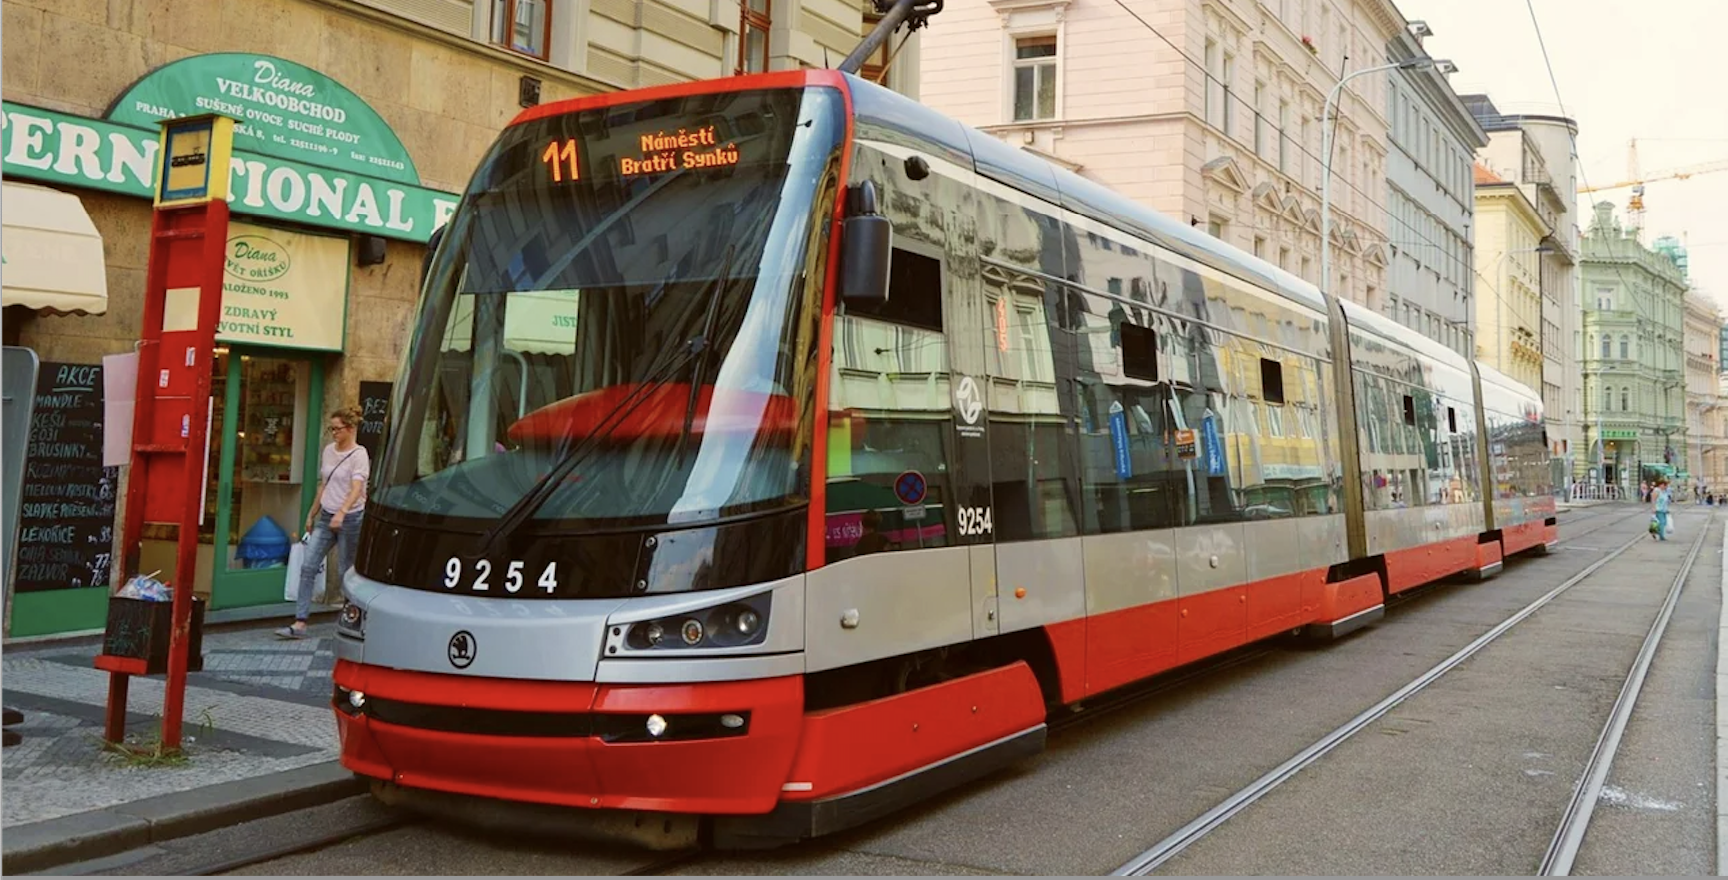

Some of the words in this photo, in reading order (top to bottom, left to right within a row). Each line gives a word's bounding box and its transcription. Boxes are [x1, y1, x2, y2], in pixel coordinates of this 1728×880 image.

[254, 60, 316, 98] Diana
[135, 101, 176, 118] PRAHA
[216, 77, 346, 123] VELKOOBCHOD
[195, 96, 244, 117] SUŠENÉ
[246, 108, 283, 126] OVOCE
[288, 119, 324, 137] SUCHÉ
[326, 128, 361, 145] PLODY
[641, 126, 715, 152] Náměstí
[542, 138, 579, 182] 11
[621, 152, 676, 175] Bratří
[682, 142, 739, 169] Synků
[234, 241, 277, 262] Diana
[224, 306, 277, 321] ZDRAVÝ
[263, 325, 294, 338] STYL
[56, 365, 100, 386] AKCE
[35, 393, 82, 409] MANDLE
[958, 506, 992, 535] 9254
[444, 556, 558, 594] 9254
